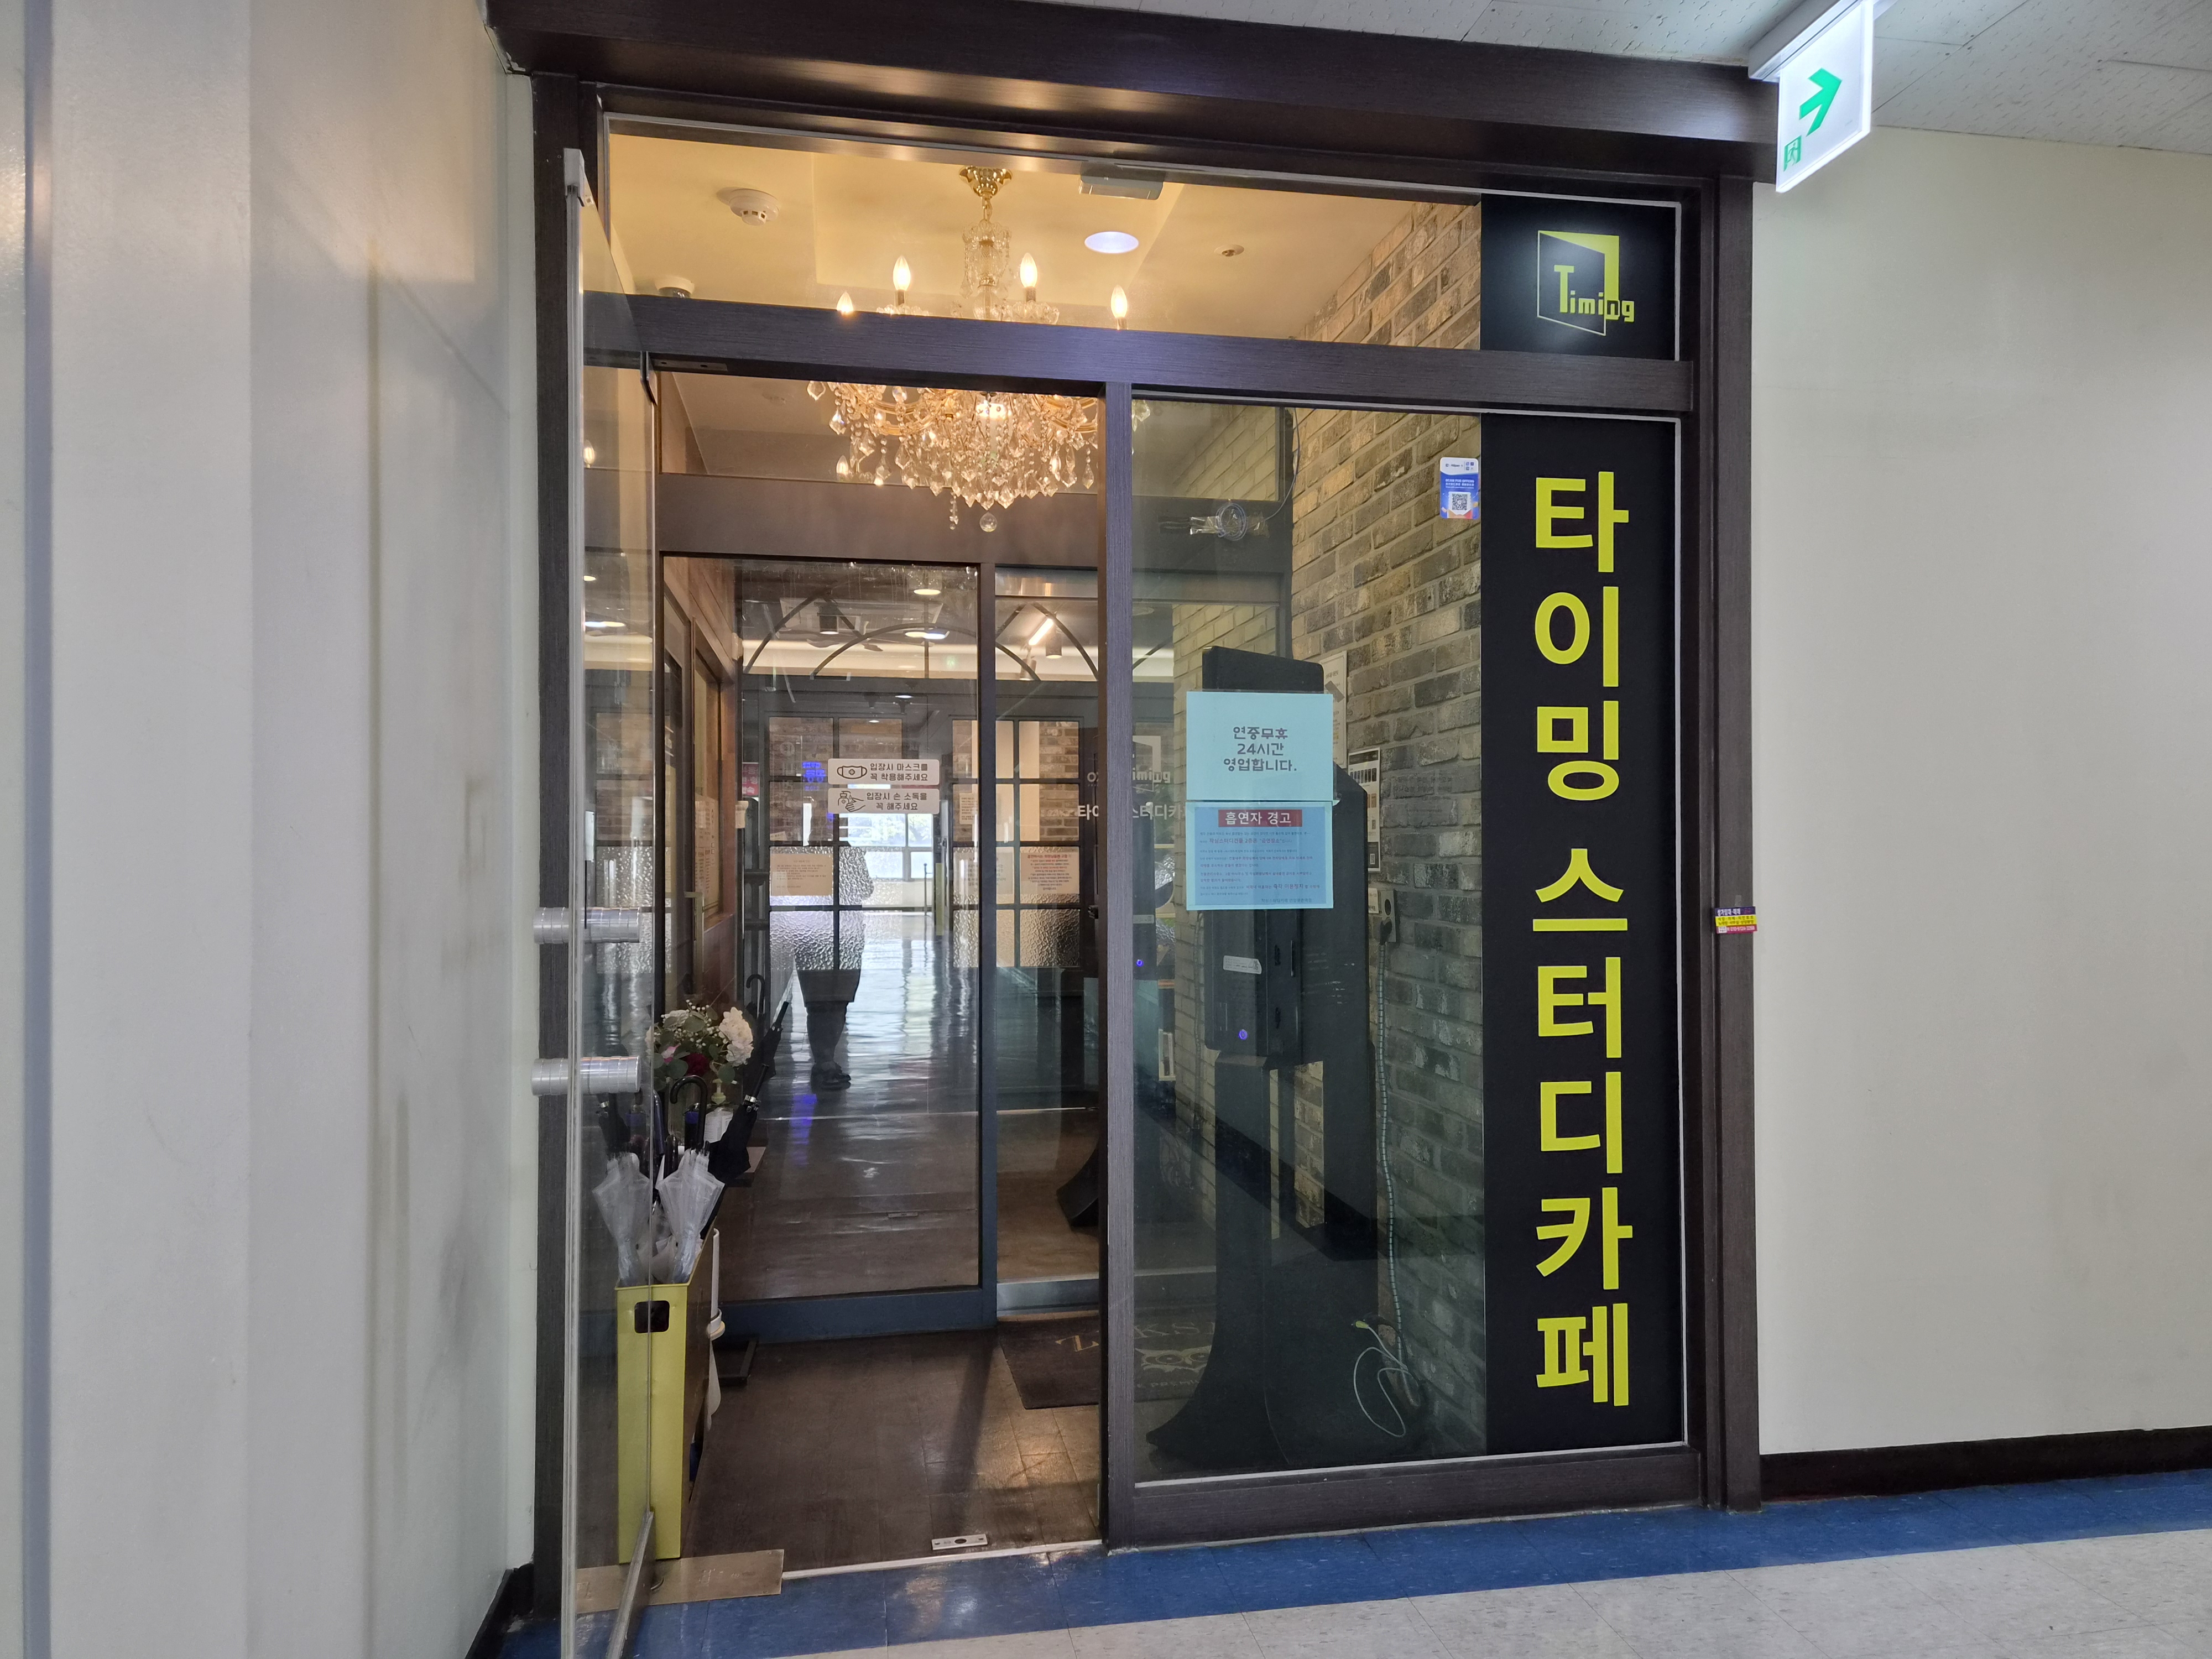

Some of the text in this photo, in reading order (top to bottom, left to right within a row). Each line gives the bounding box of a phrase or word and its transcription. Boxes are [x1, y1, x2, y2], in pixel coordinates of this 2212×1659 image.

[1553, 264, 1635, 322] Timing
[1233, 726, 1288, 740] 연중무휴
[1237, 743, 1284, 756] 24시간
[1223, 758, 1297, 772] 영업합니다.
[1133, 767, 1171, 784] iming
[1225, 812, 1292, 825] 흡연자 경고
